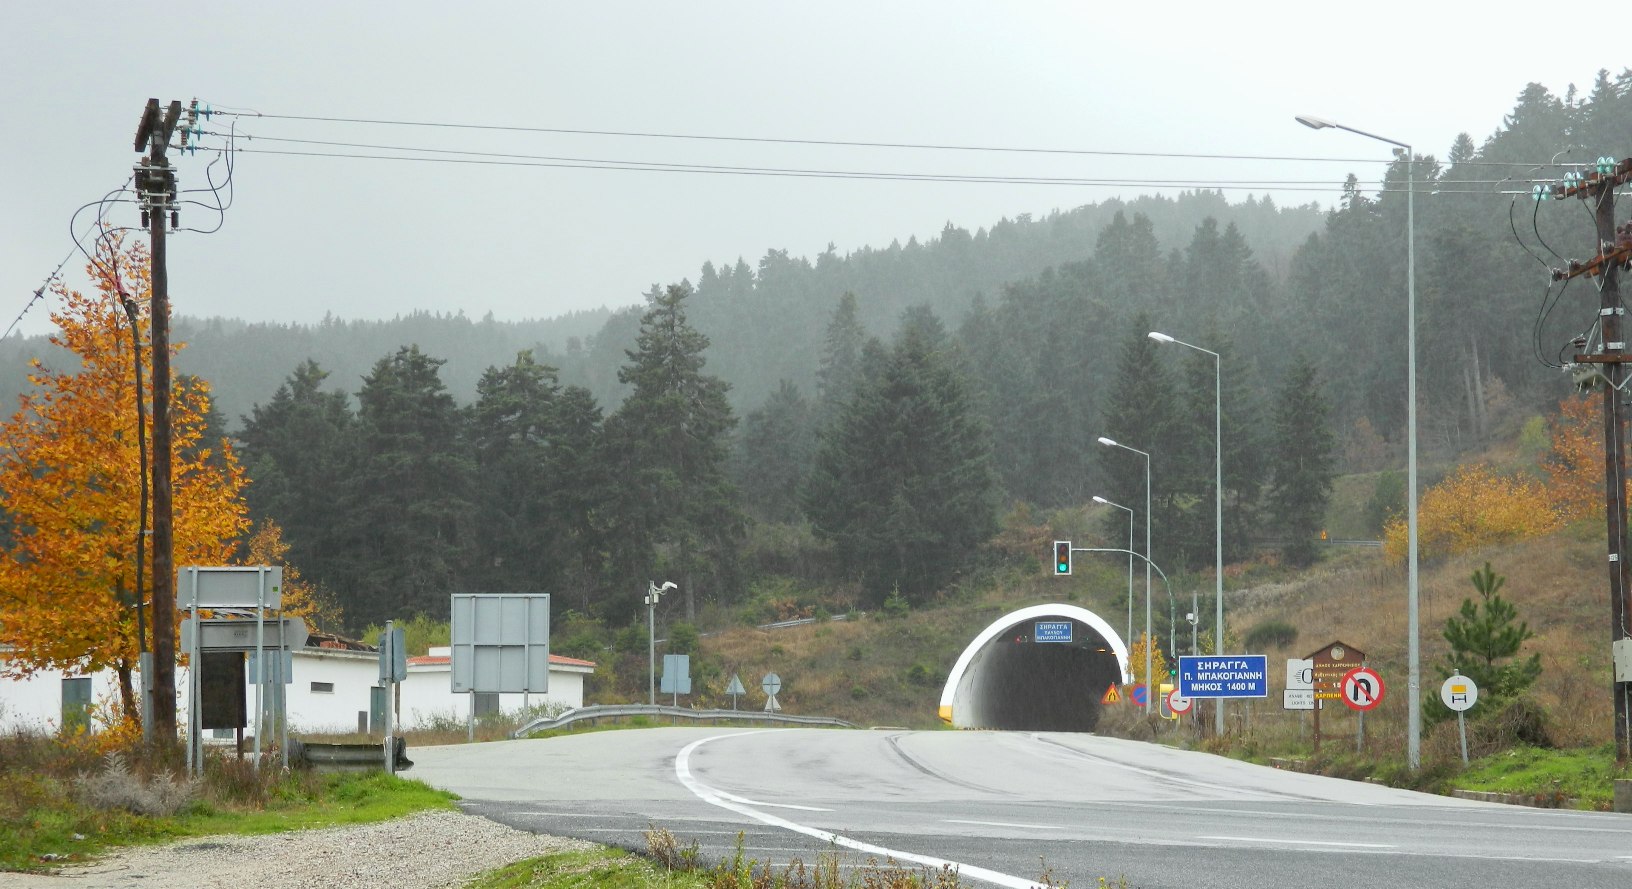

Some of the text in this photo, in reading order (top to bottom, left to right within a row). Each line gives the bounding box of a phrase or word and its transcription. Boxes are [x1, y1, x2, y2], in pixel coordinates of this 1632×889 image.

[1197, 661, 1249, 670] ΣΗΡΑΓΓΑ
[1184, 671, 1263, 681] Π. ΜΠΑΚΟΓΙΑΝΝΗ
[1191, 682, 1256, 691] ΜΗΚΟΣ 1400 Μ
